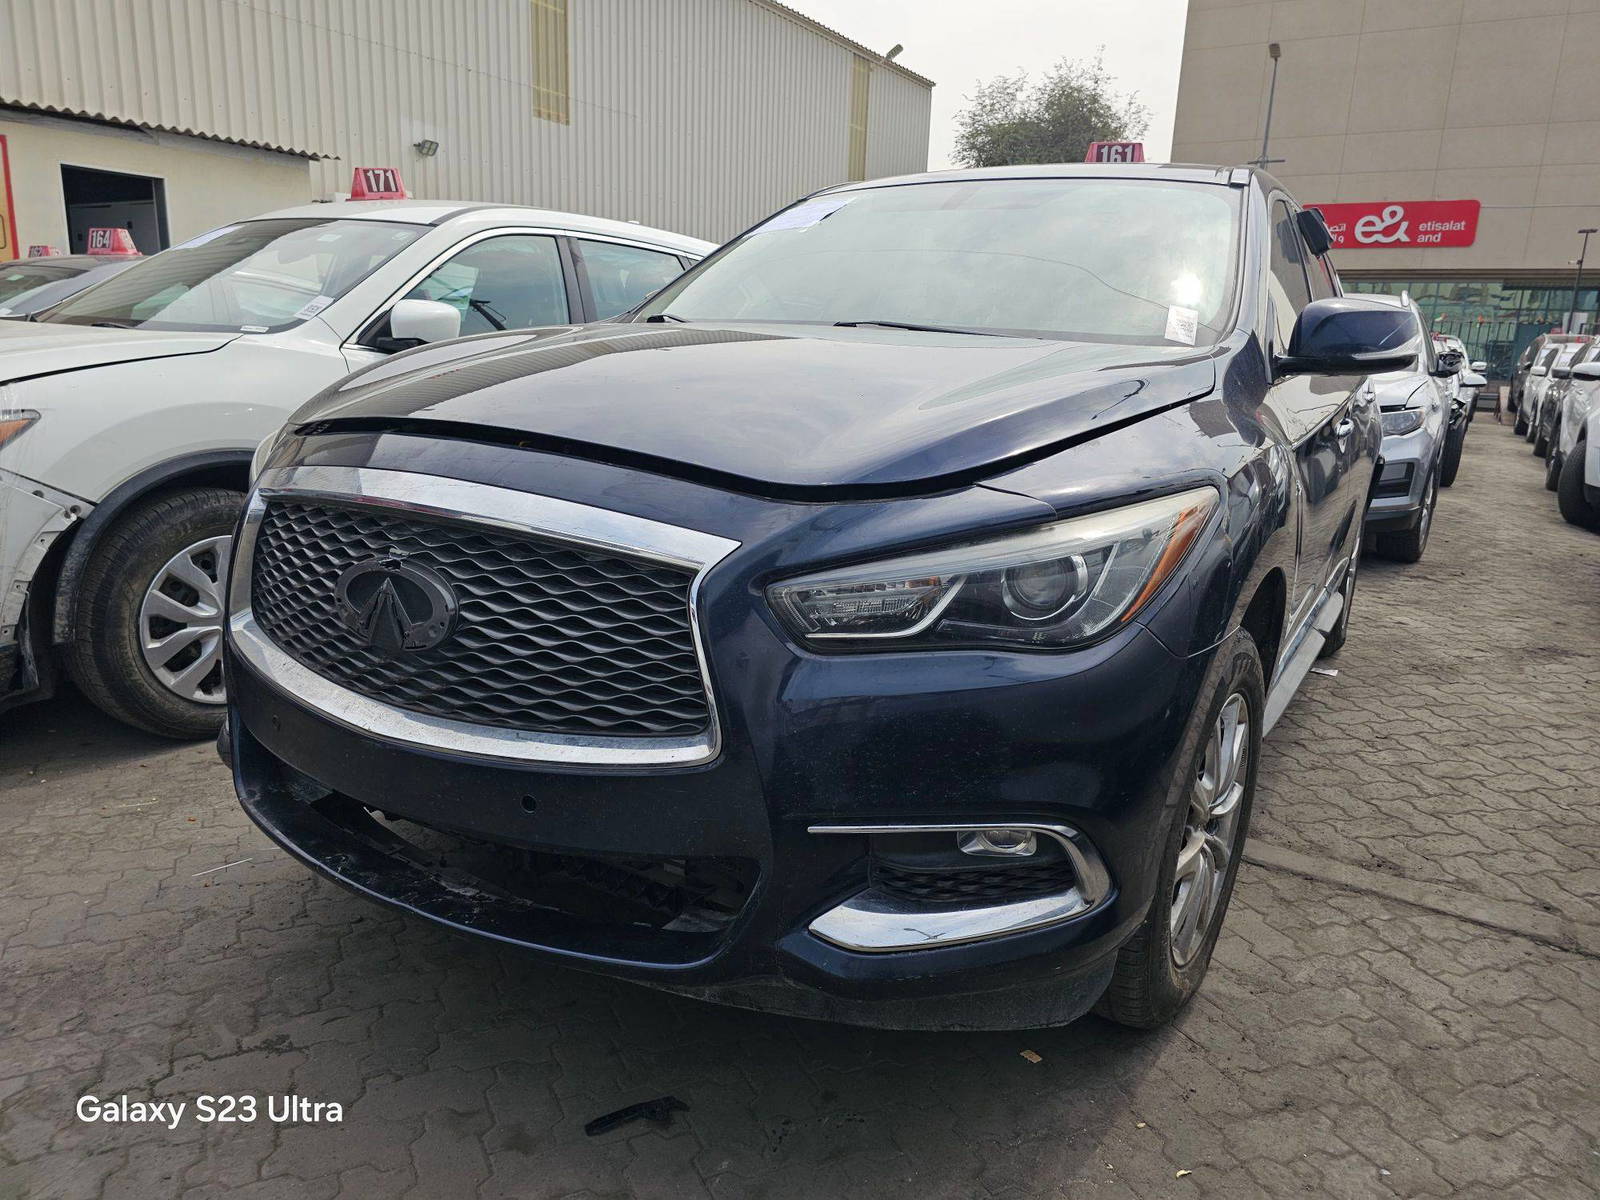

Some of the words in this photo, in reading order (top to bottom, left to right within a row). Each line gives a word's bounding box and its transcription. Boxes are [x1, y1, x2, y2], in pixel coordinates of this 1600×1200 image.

[1101, 145, 1133, 162] 161
[367, 170, 396, 191] 171
[1354, 205, 1411, 244] e&
[1419, 221, 1466, 232] etisalat
[92, 231, 110, 248] 164
[1417, 233, 1441, 243] and
